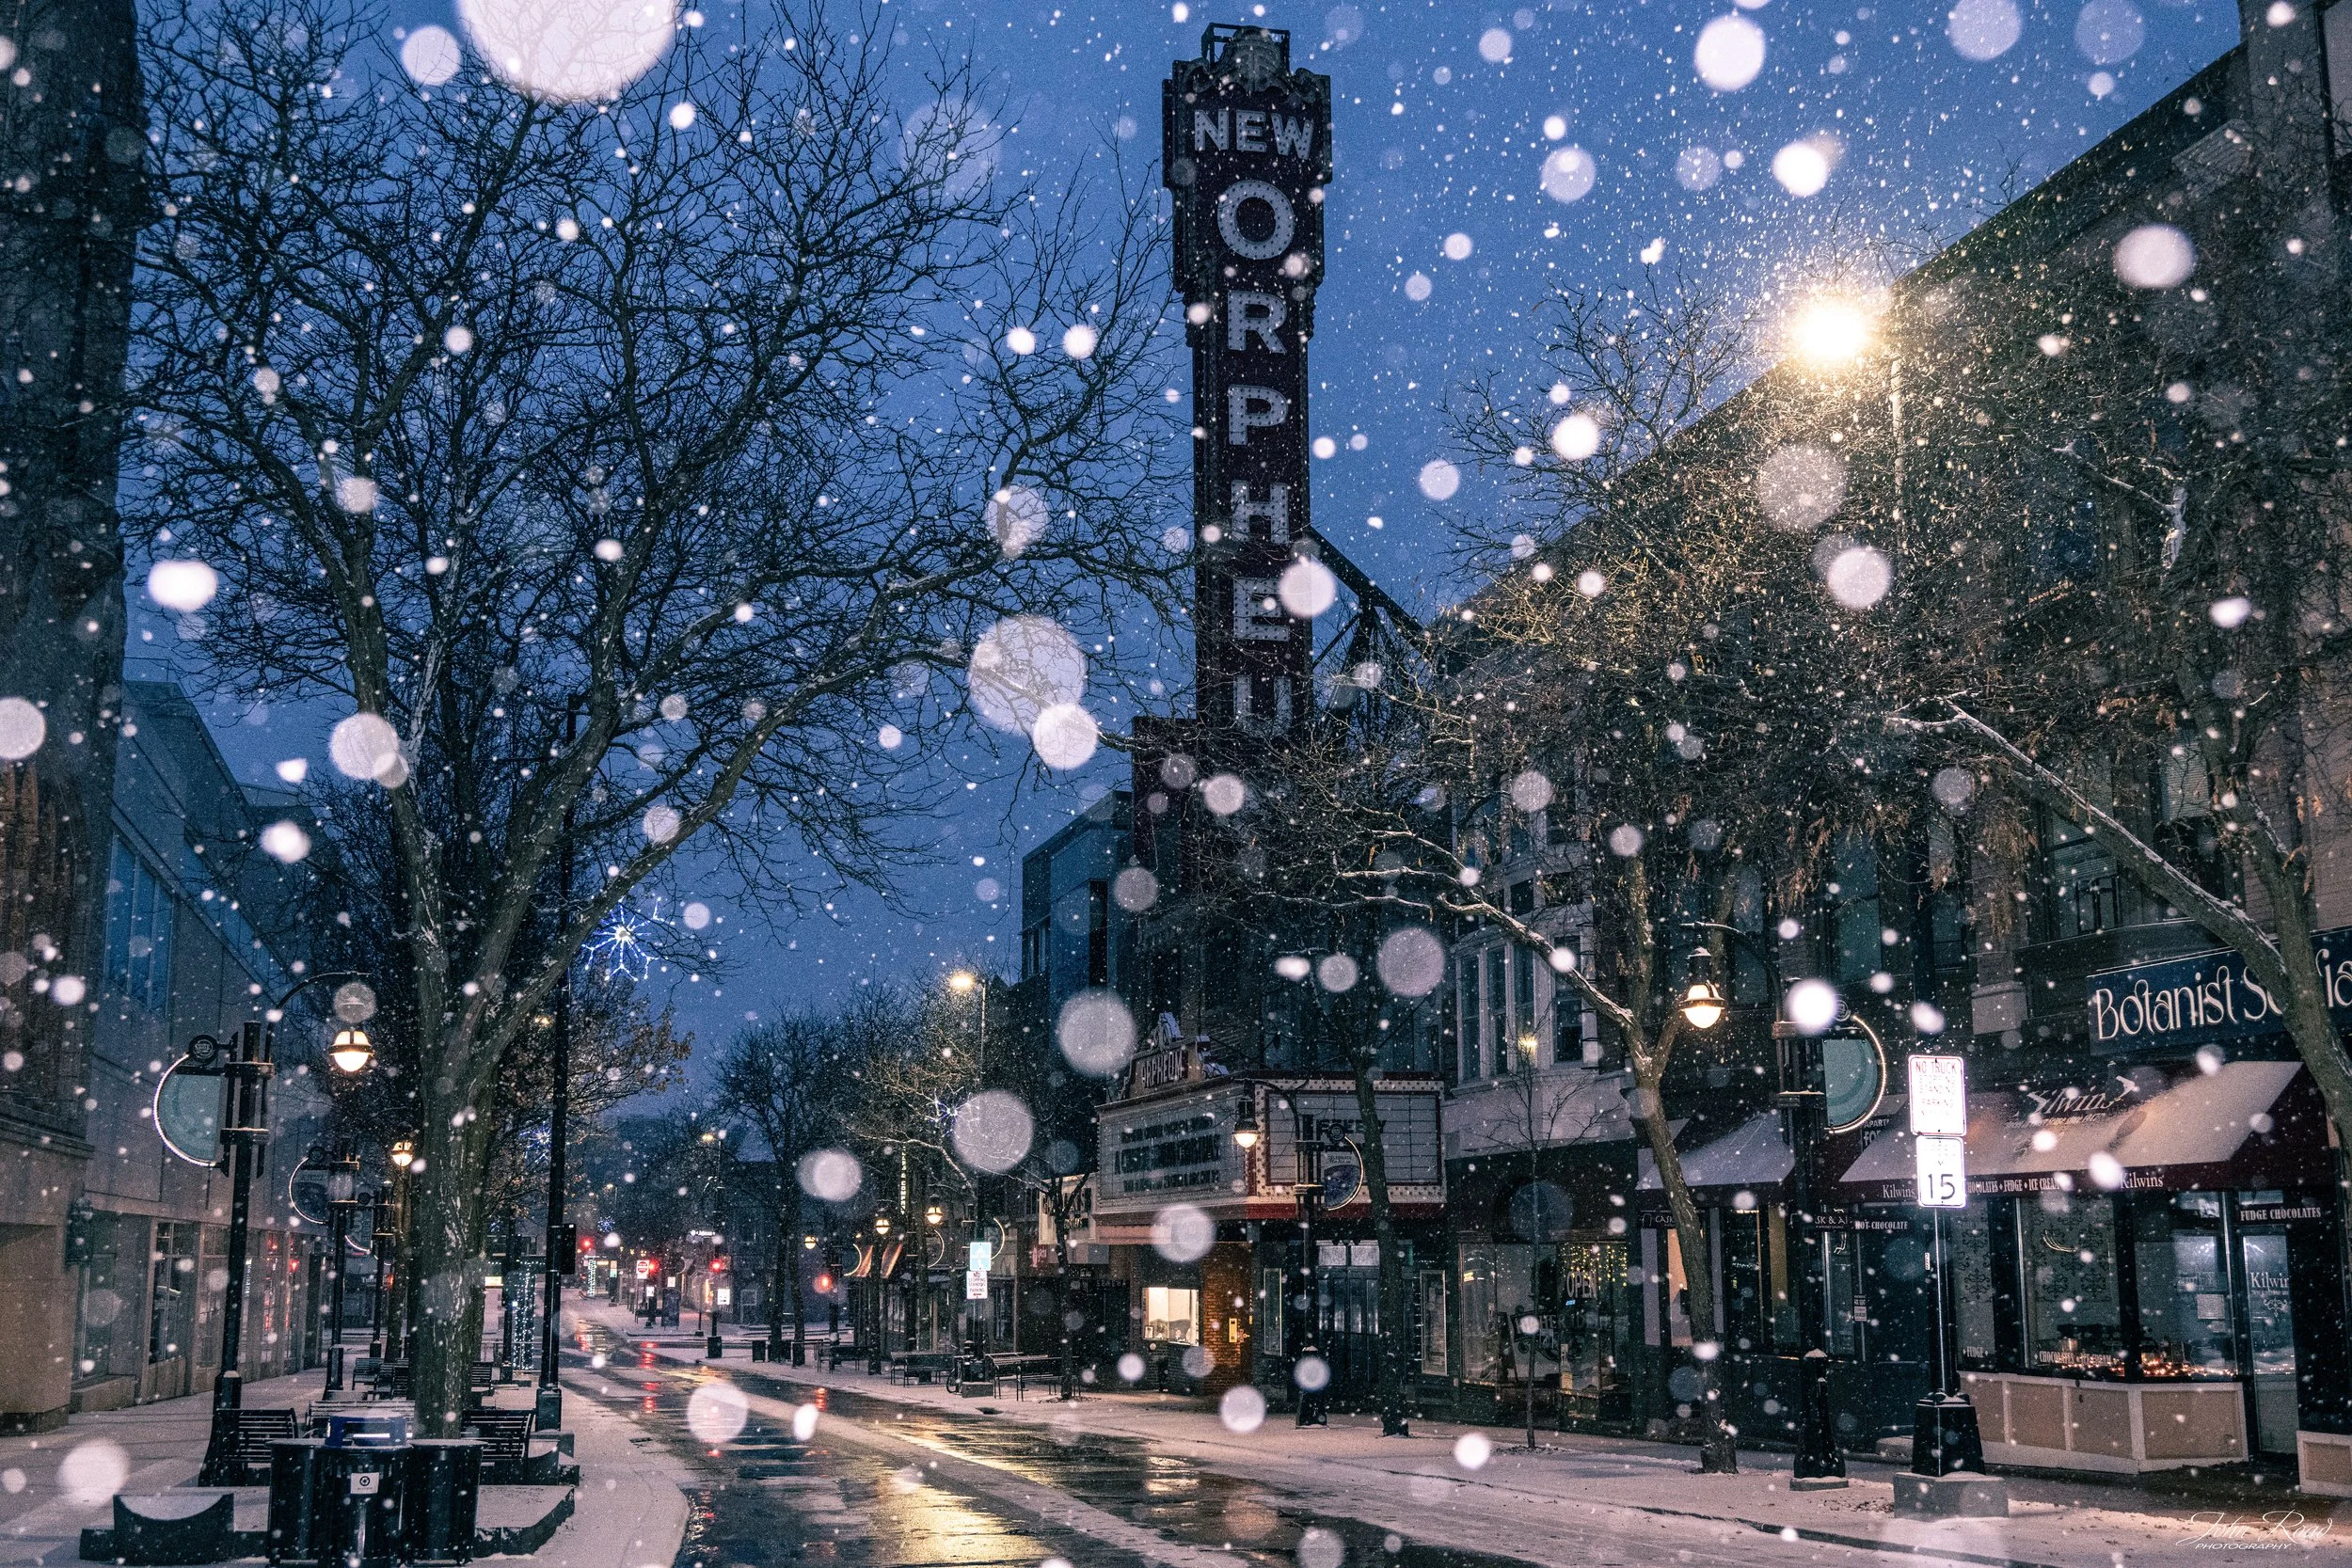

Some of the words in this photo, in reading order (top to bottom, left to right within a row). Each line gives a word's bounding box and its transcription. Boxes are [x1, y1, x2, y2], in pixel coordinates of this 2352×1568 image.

[1194, 109, 1314, 161] NEW
[2095, 965, 2239, 1040] Botanist
[1915, 1060, 1928, 1074] NO
[1931, 1061, 1957, 1074] TRUCK
[1882, 1183, 1915, 1199] Kilwins
[1966, 1180, 1999, 1195] HOCOLATES
[2002, 1179, 2023, 1193] FUDGE
[2028, 1178, 2039, 1191] ICE
[1928, 1173, 1956, 1200] 15
[2240, 1210, 2268, 1222] FUDGE
[2269, 1207, 2322, 1220] CHOCOLATES
[1566, 1271, 1598, 1299] OPEN
